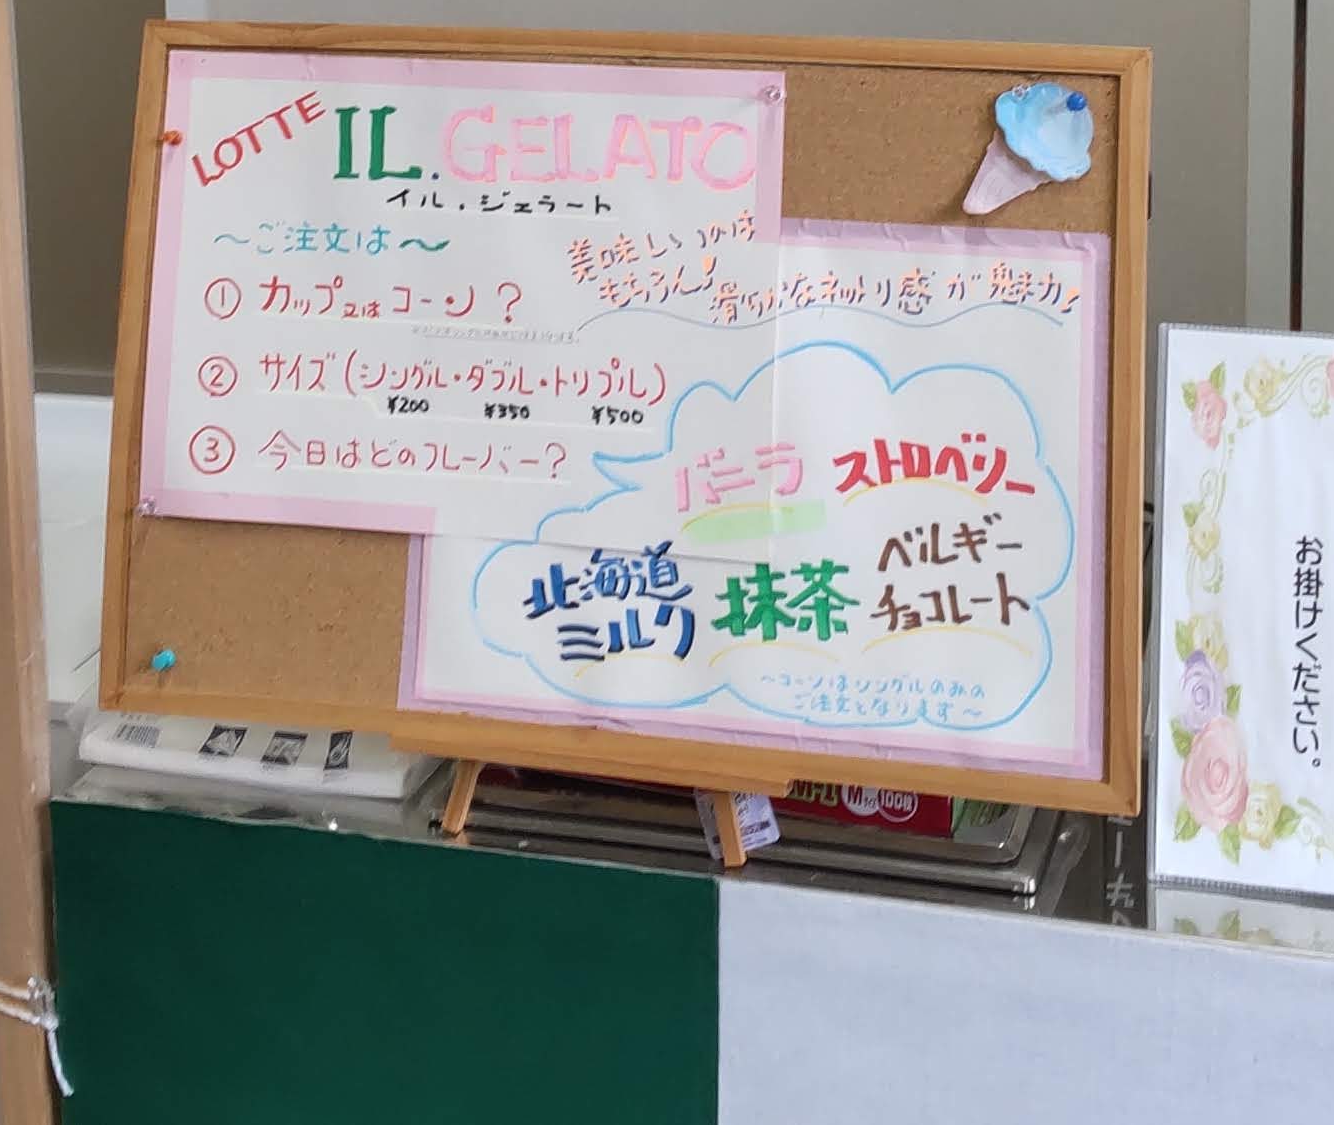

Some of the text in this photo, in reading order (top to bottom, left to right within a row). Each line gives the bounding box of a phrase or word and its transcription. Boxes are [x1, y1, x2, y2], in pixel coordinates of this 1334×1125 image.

[191, 90, 327, 187] LOTTE
[386, 396, 646, 427] ¥200 ¥350 ¥500
[676, 443, 804, 513] バニラ
[832, 432, 1036, 495] ストロベリー
[877, 511, 1024, 572] ベルギー
[523, 539, 694, 620] 北海道
[710, 558, 861, 643] 抹茶
[870, 571, 1031, 632] チョコレート
[556, 600, 697, 663] ミルク
[1291, 535, 1325, 769] お掛けください。
